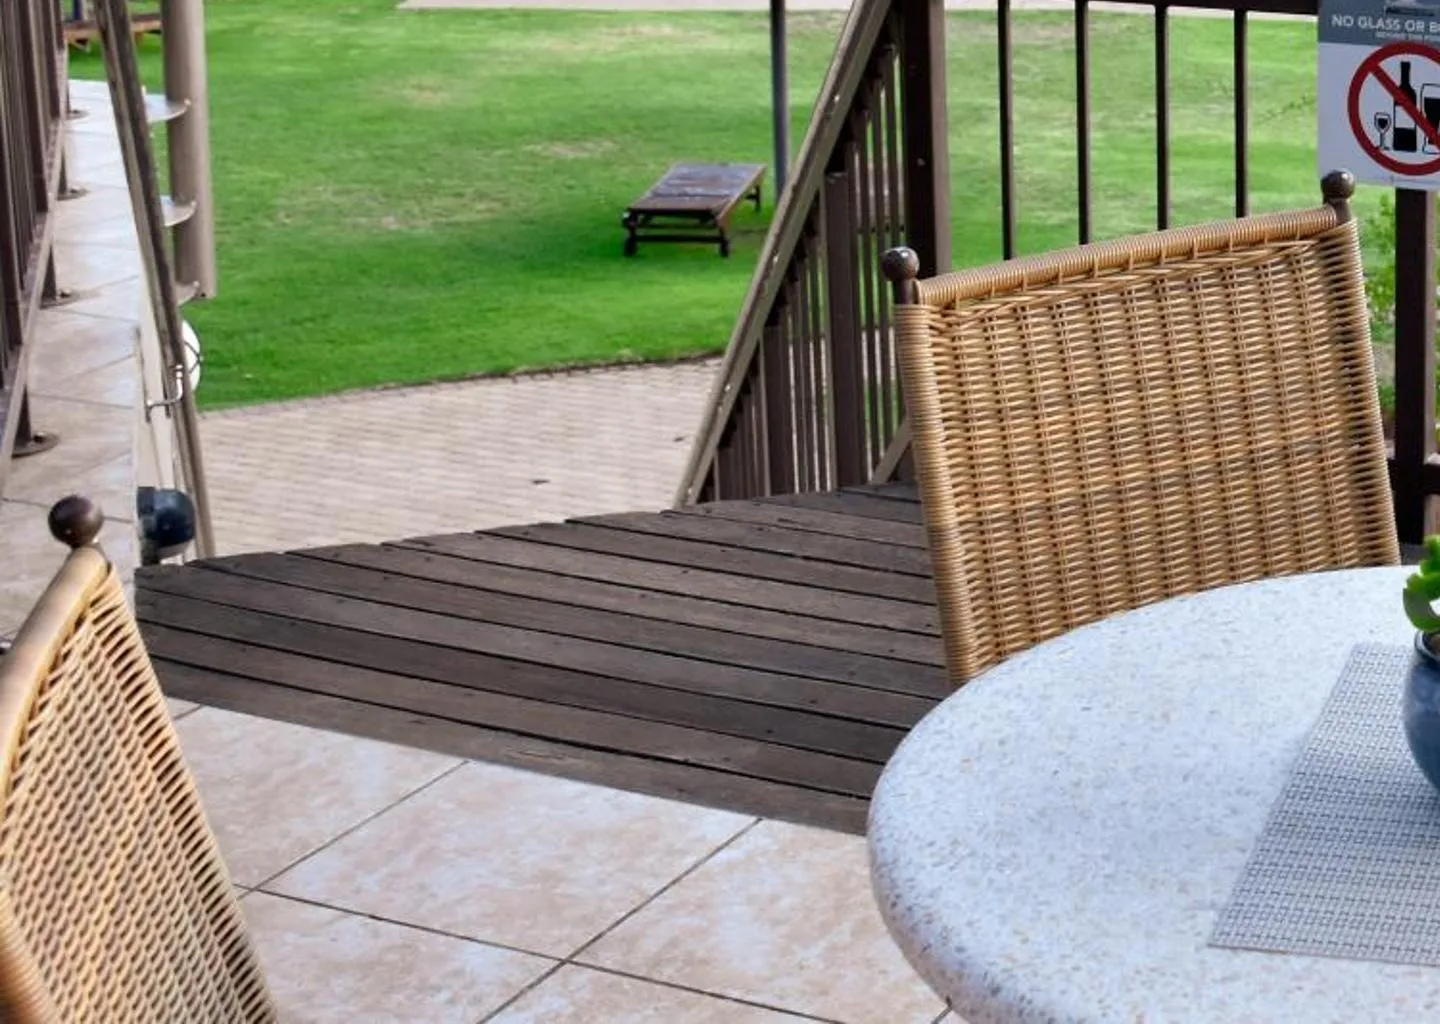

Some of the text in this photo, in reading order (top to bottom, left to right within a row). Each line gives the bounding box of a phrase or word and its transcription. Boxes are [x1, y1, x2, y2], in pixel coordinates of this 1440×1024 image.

[1331, 14, 1354, 28] NO
[1358, 16, 1401, 31] GLASS
[1404, 20, 1425, 33] OR
